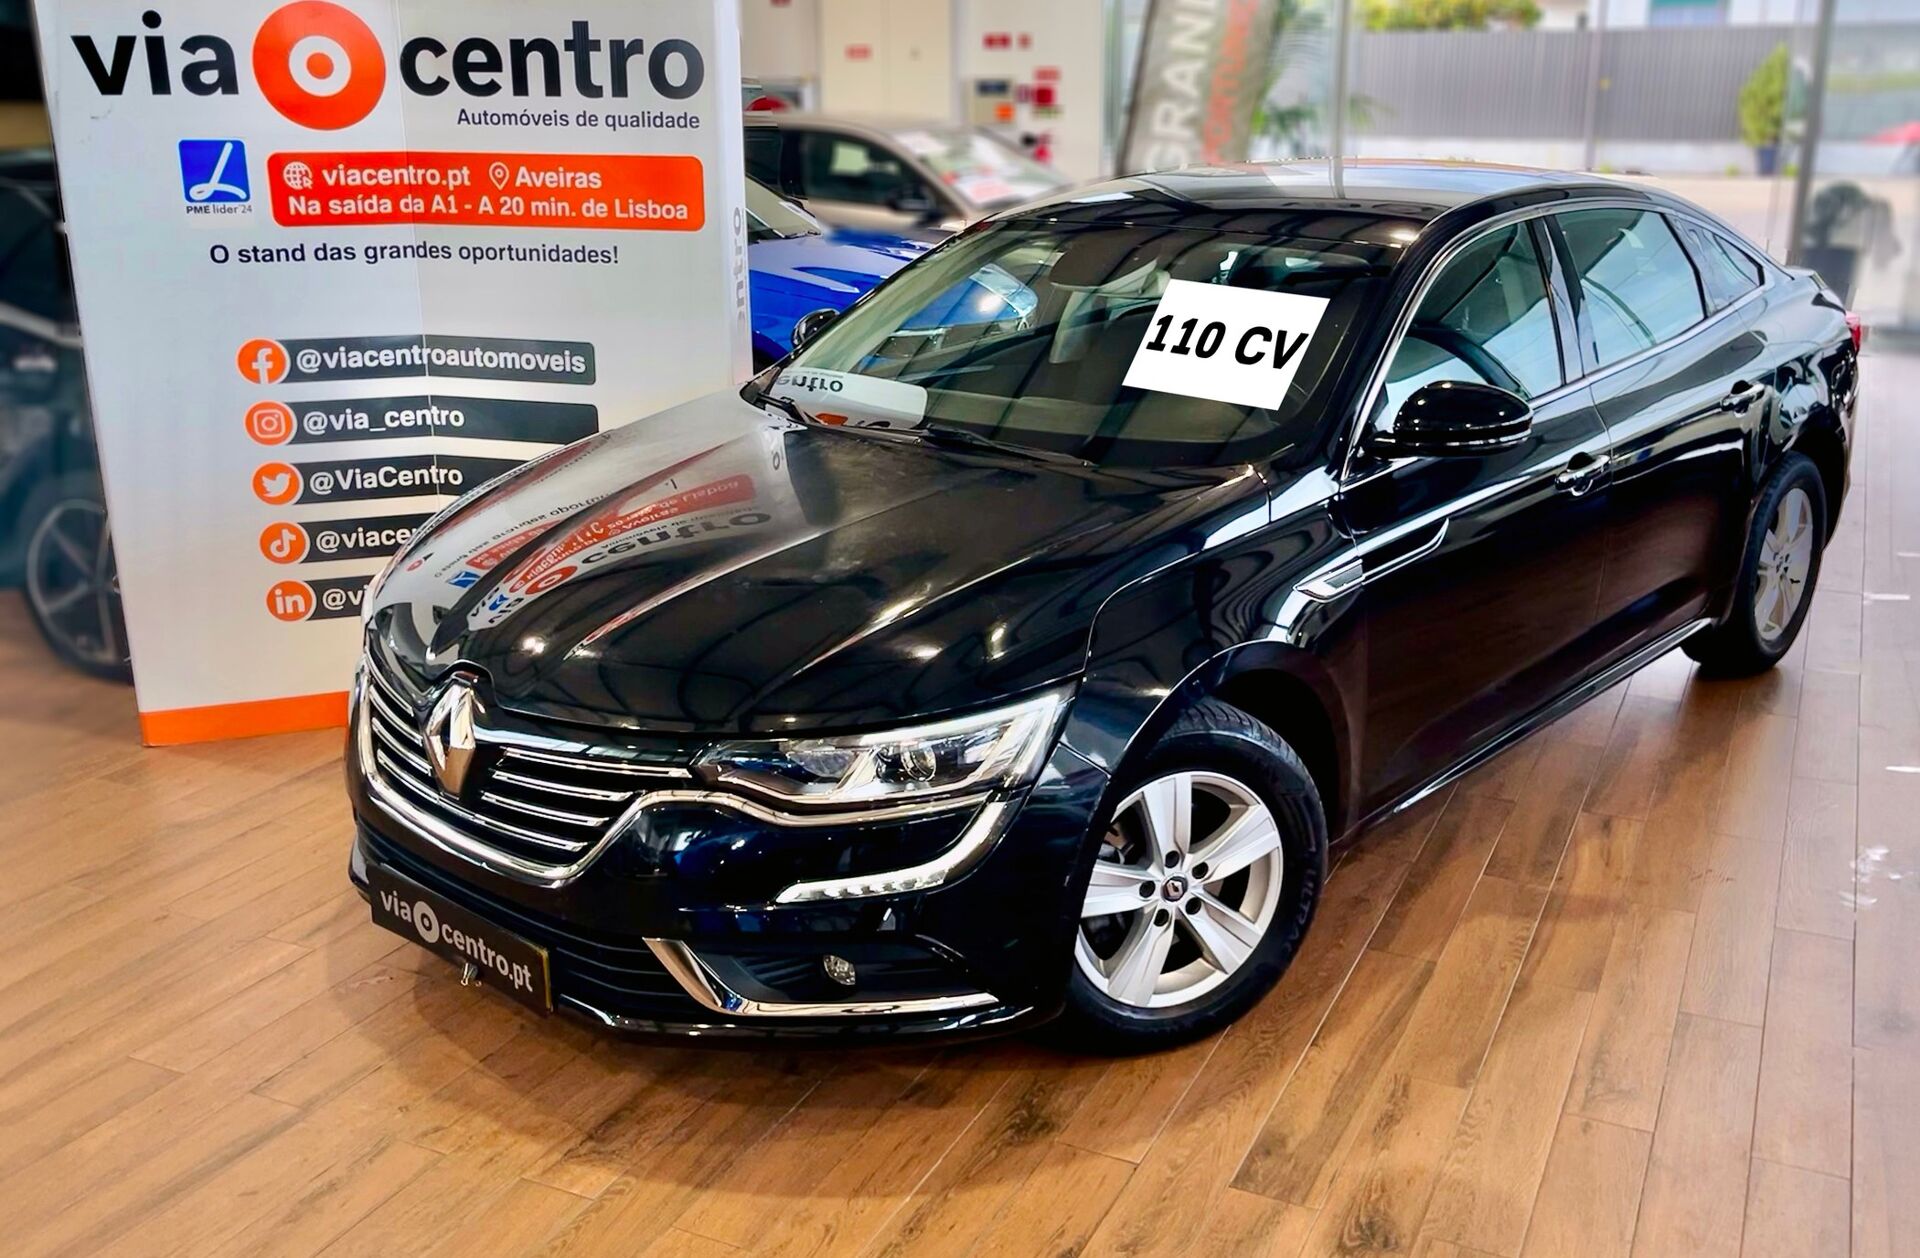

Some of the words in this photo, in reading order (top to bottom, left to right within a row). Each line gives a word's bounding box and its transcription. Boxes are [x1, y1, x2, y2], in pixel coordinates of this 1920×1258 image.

[70, 9, 239, 96] via
[399, 20, 705, 100] centro
[456, 108, 570, 127] Automóveis
[575, 110, 599, 128] de
[604, 111, 701, 131] qualidade
[321, 163, 471, 191] viacentro.pt
[515, 165, 603, 189] Aveiras
[186, 205, 211, 214] PME
[288, 195, 322, 216] Na
[328, 194, 393, 215] saída
[399, 194, 425, 213] da
[430, 194, 459, 214] A1
[478, 195, 495, 215] A
[499, 196, 526, 216] 20
[530, 197, 577, 217] min.
[581, 198, 609, 217] de
[614, 199, 689, 220] Lisboa
[209, 244, 229, 264] O
[238, 243, 306, 263] stand
[313, 242, 357, 262] das
[364, 241, 452, 264] grandes
[457, 244, 619, 265] oportunidades!
[296, 345, 587, 374] @viacentroautomoveis
[302, 404, 466, 435] @via_centro
[309, 464, 464, 496] @ViaCentro
[315, 526, 417, 553] @viace
[380, 889, 412, 924] via
[441, 922, 534, 993] centro.pt
